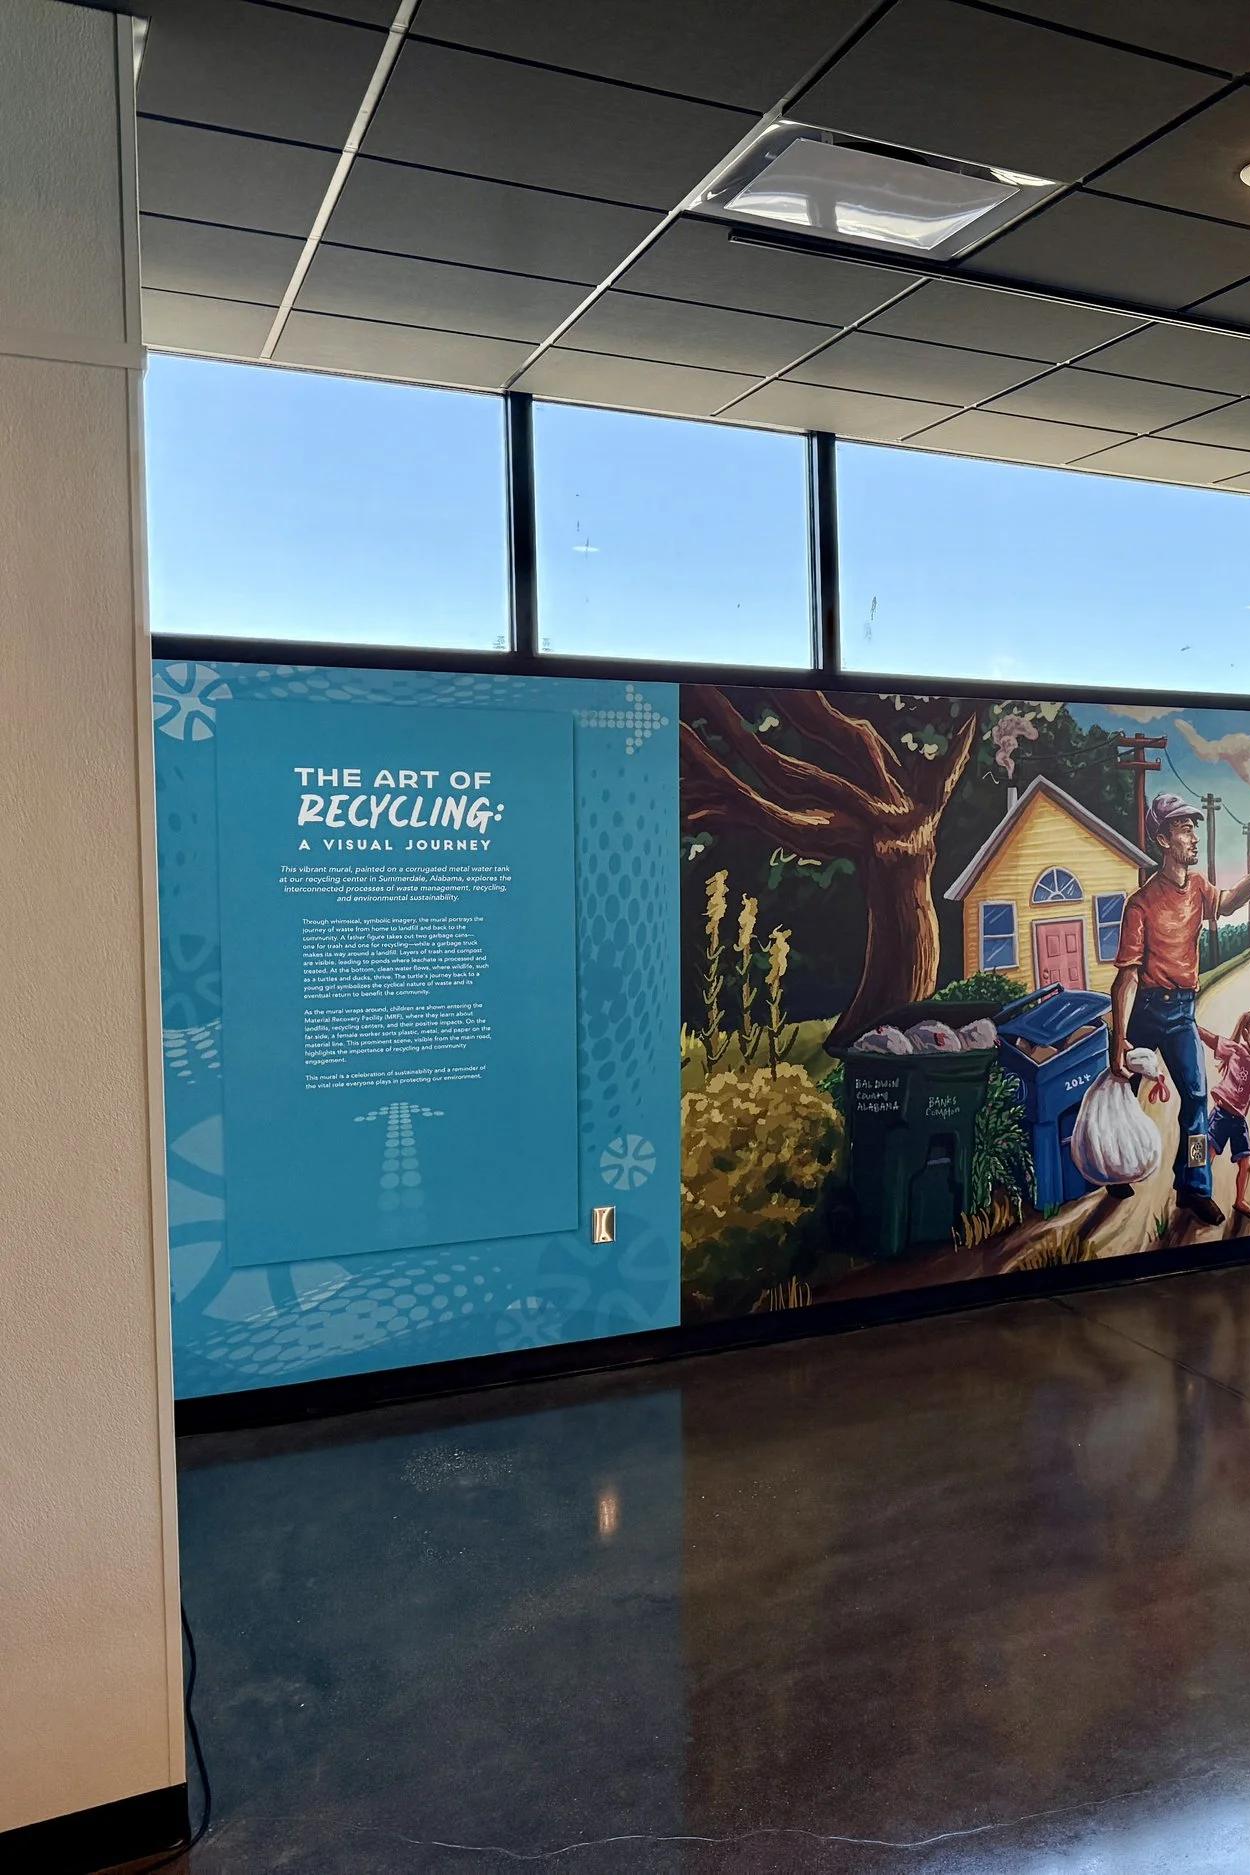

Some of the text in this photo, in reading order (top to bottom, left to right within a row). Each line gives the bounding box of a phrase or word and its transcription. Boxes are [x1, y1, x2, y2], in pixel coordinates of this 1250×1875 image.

[294, 768, 491, 789] THE ART OF
[298, 794, 504, 833] RECYCLING:
[299, 840, 492, 851] A VISUAL JOURNEY
[328, 865, 355, 873] mural,
[355, 865, 385, 874] painted
[405, 865, 447, 874] corrugated
[305, 875, 341, 884] recycling
[378, 874, 428, 882] Summerdale,
[429, 874, 466, 882] Alabama,
[466, 874, 498, 883] explores
[420, 885, 472, 893] management,
[1065, 1073, 1091, 1091] 2024
